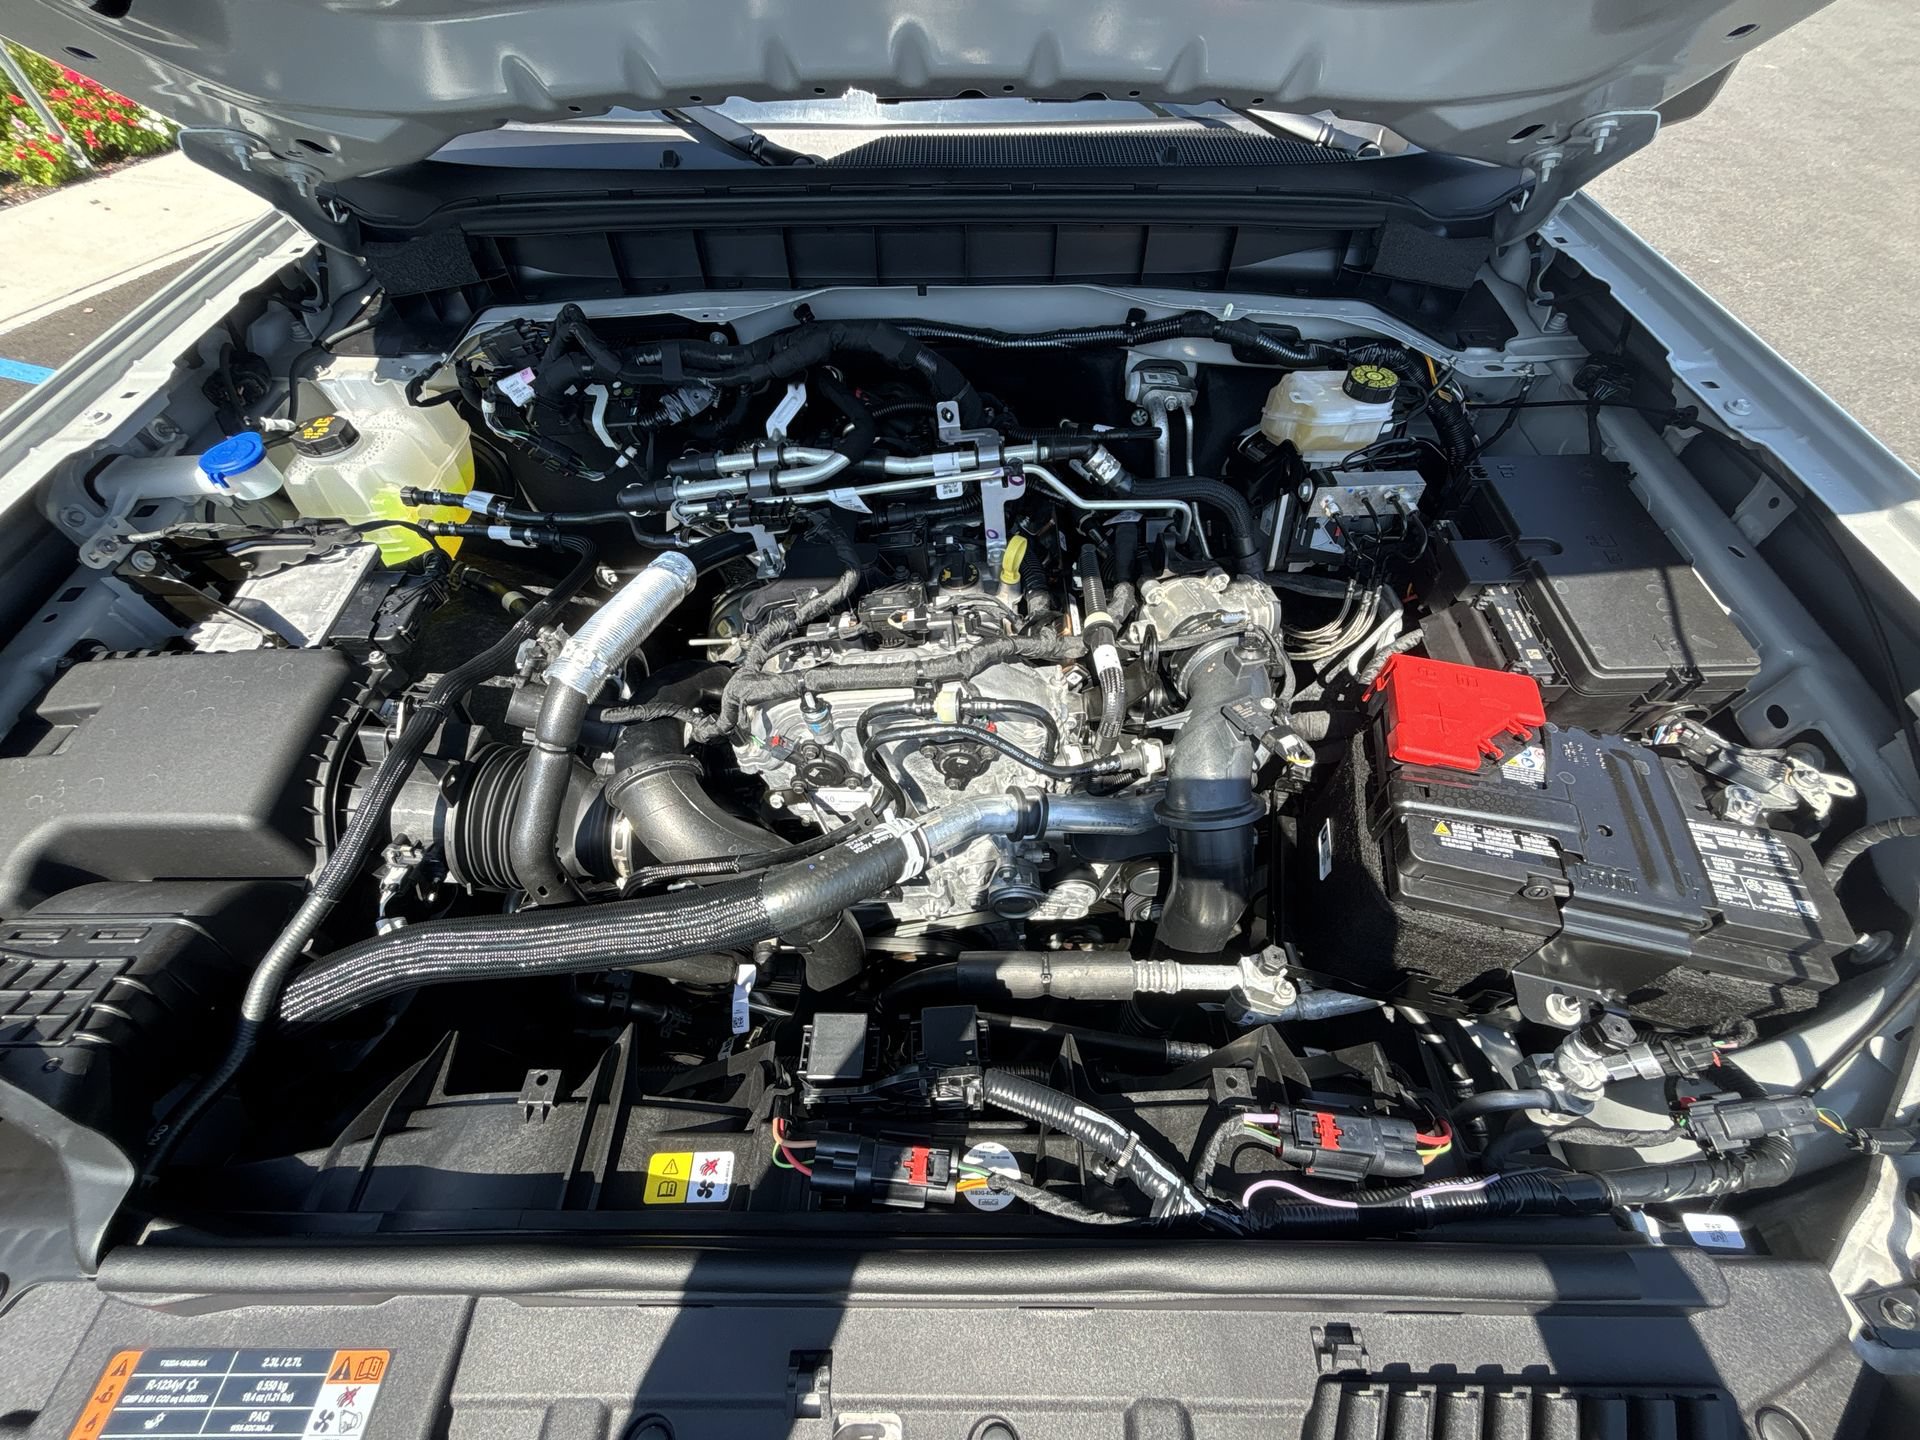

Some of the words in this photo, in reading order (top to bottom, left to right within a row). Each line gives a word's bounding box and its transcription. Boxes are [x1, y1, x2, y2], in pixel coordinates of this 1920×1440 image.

[145, 1379, 187, 1393] R-1234yf
[277, 1381, 289, 1393] kg
[248, 1411, 271, 1423] PAG
